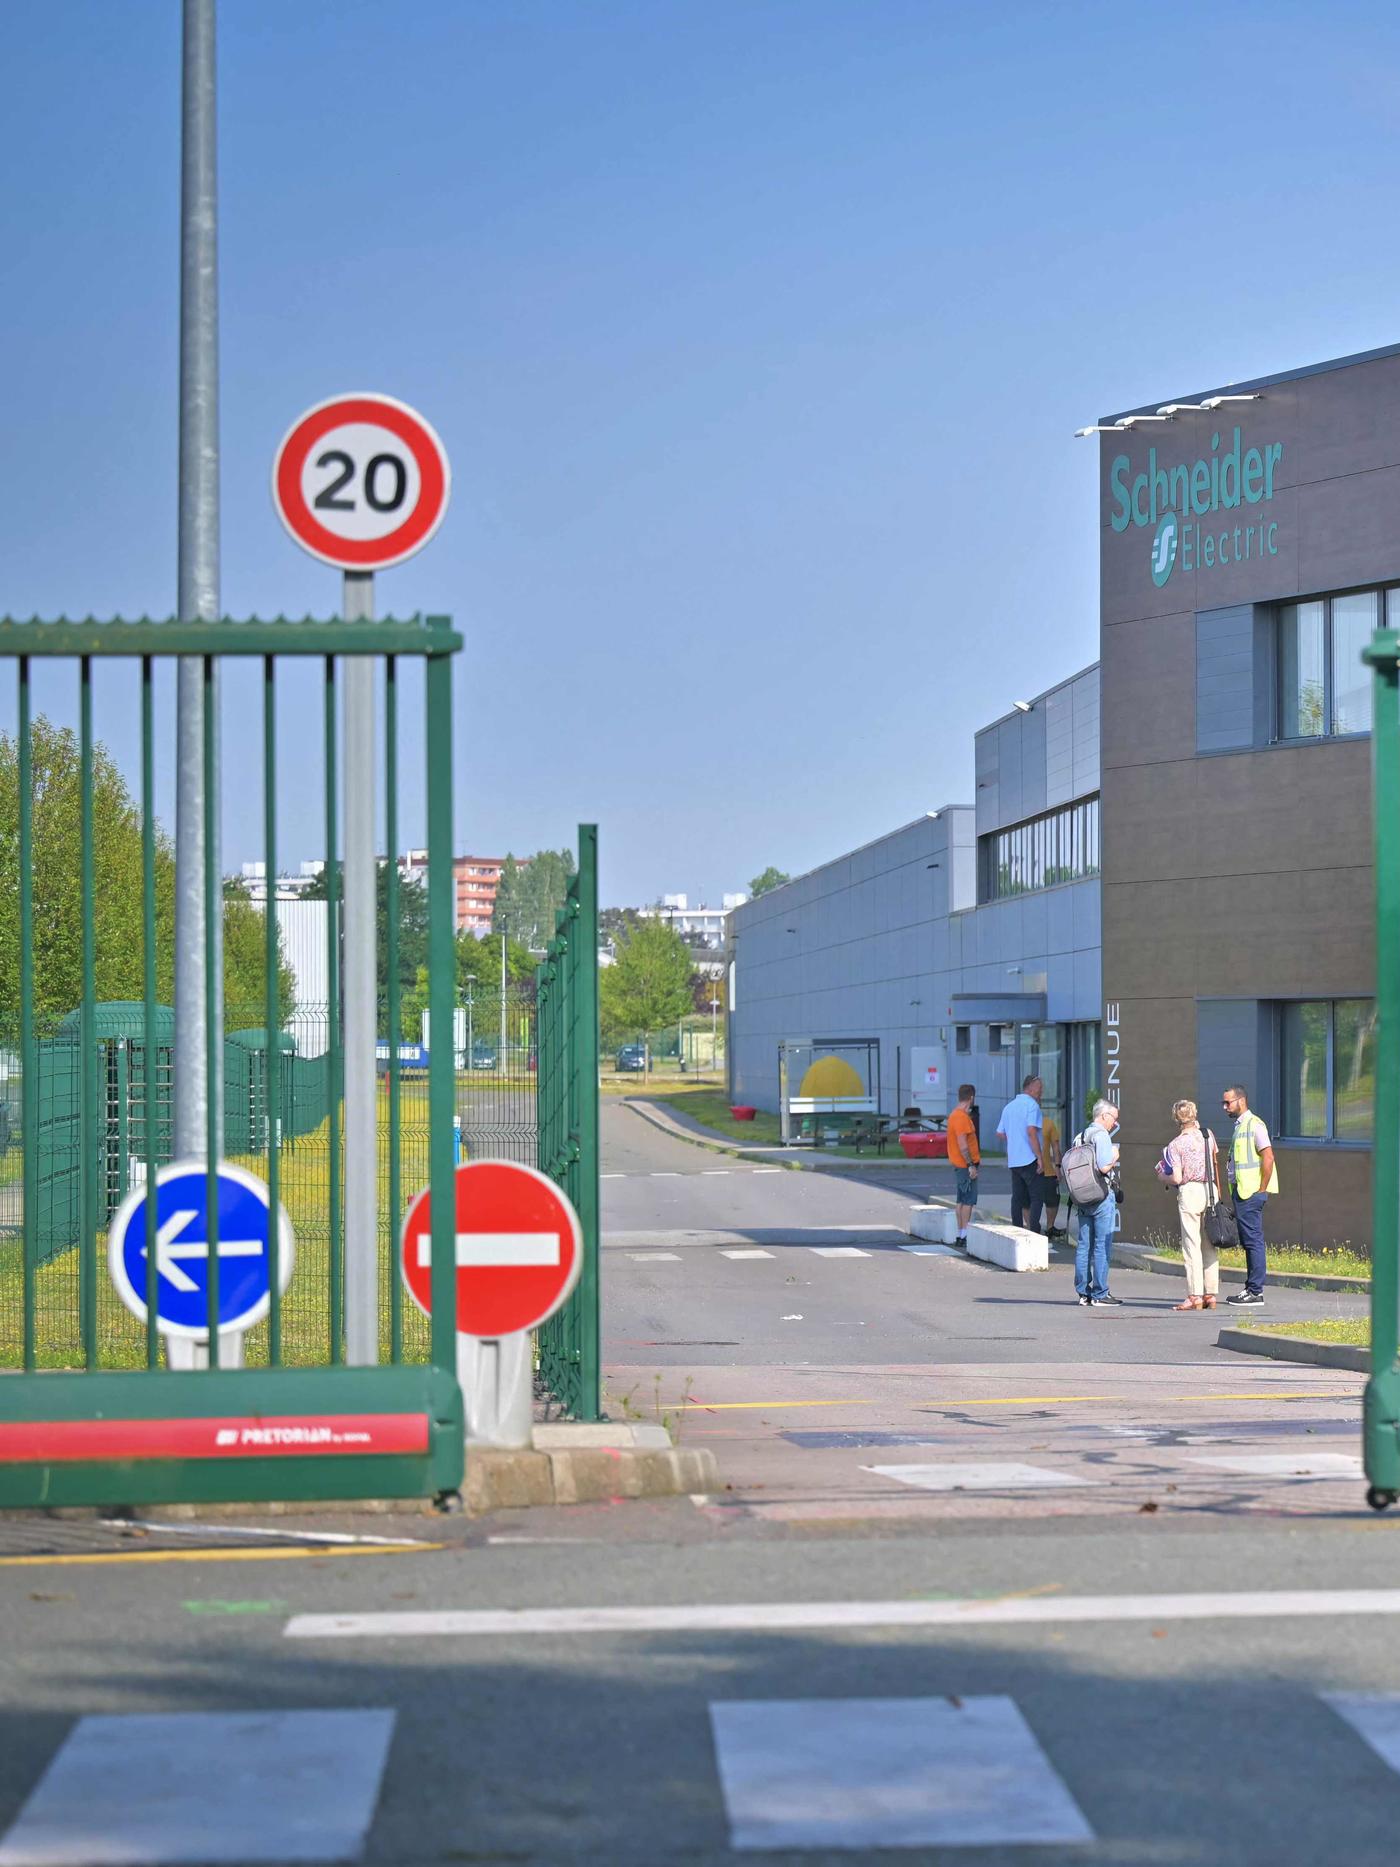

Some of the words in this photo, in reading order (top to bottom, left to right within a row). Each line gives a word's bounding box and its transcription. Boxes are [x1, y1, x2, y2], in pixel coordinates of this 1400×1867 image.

[314, 450, 407, 514] 20
[1111, 426, 1283, 532] Schneider
[1182, 513, 1278, 571] Electric
[241, 1428, 332, 1445] PRETORIAN
